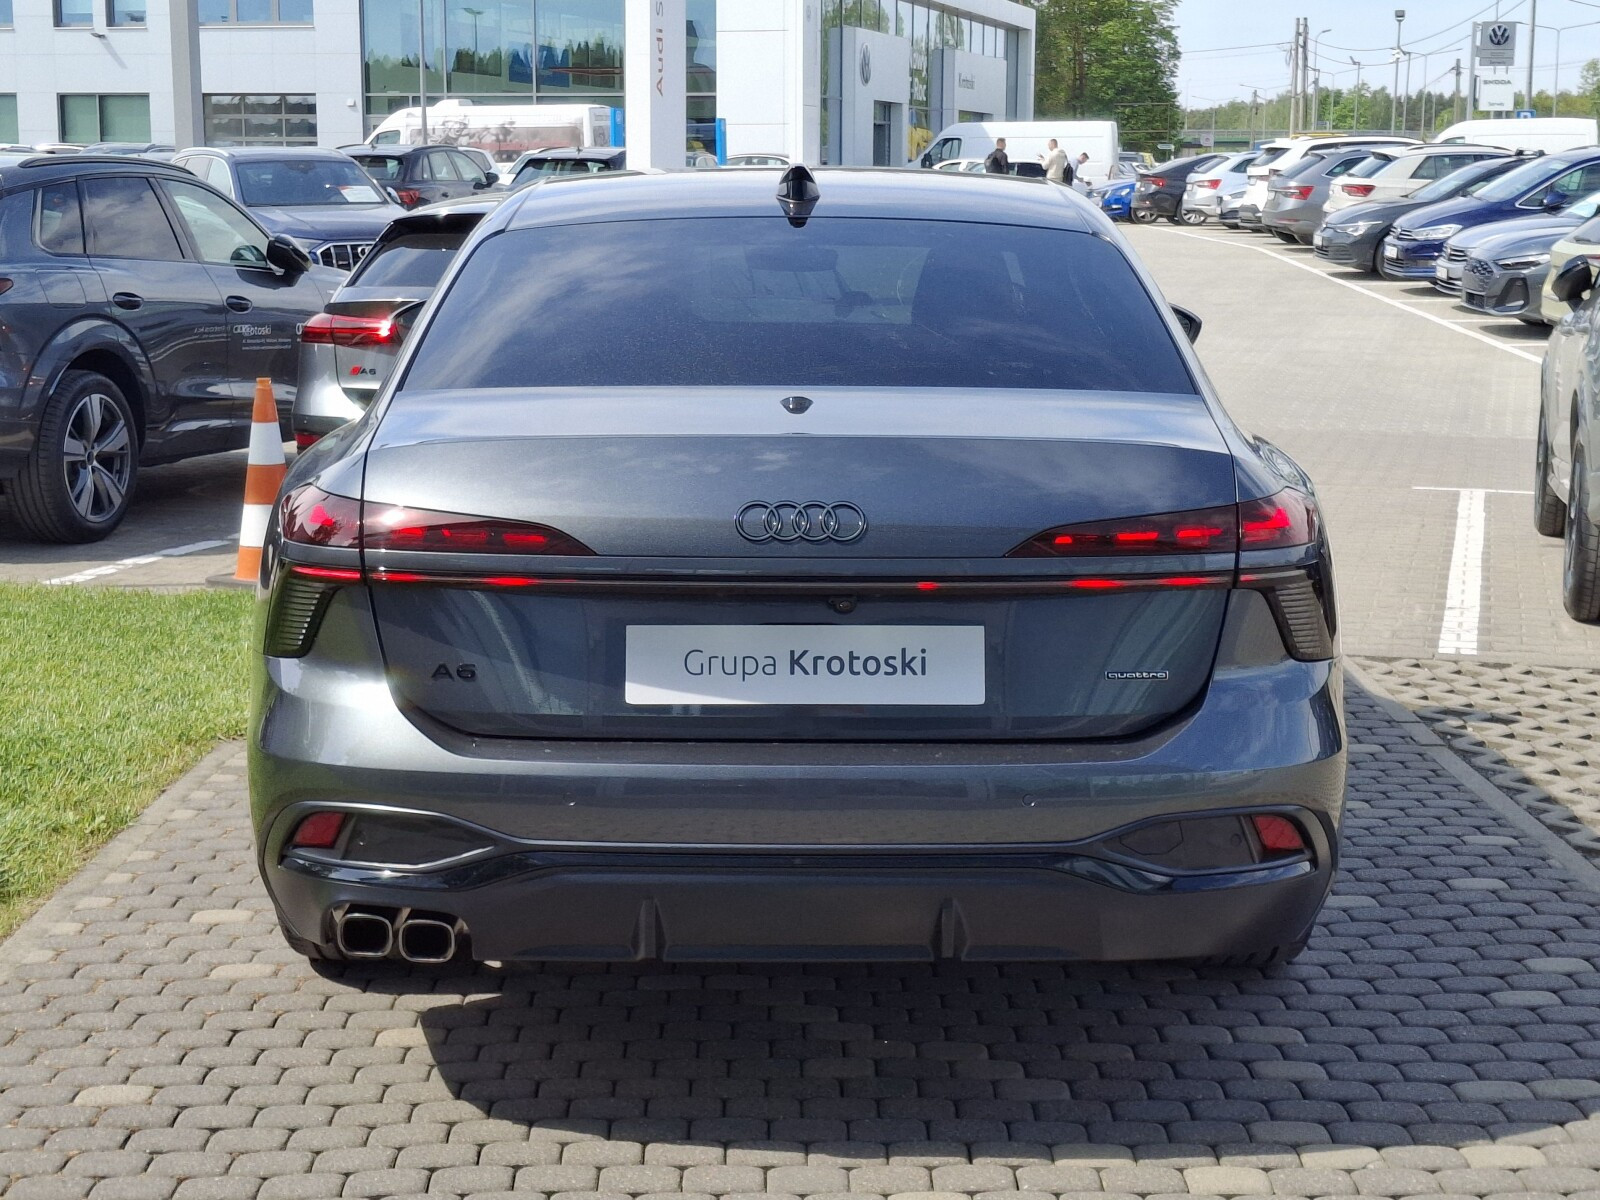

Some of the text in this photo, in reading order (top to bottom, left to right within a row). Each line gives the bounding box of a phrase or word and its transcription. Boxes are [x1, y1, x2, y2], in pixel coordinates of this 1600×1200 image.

[656, 28, 664, 97] Audi
[431, 663, 477, 681] A6
[683, 647, 928, 682] Grupa Krotoski
[1107, 671, 1167, 680] quattro
